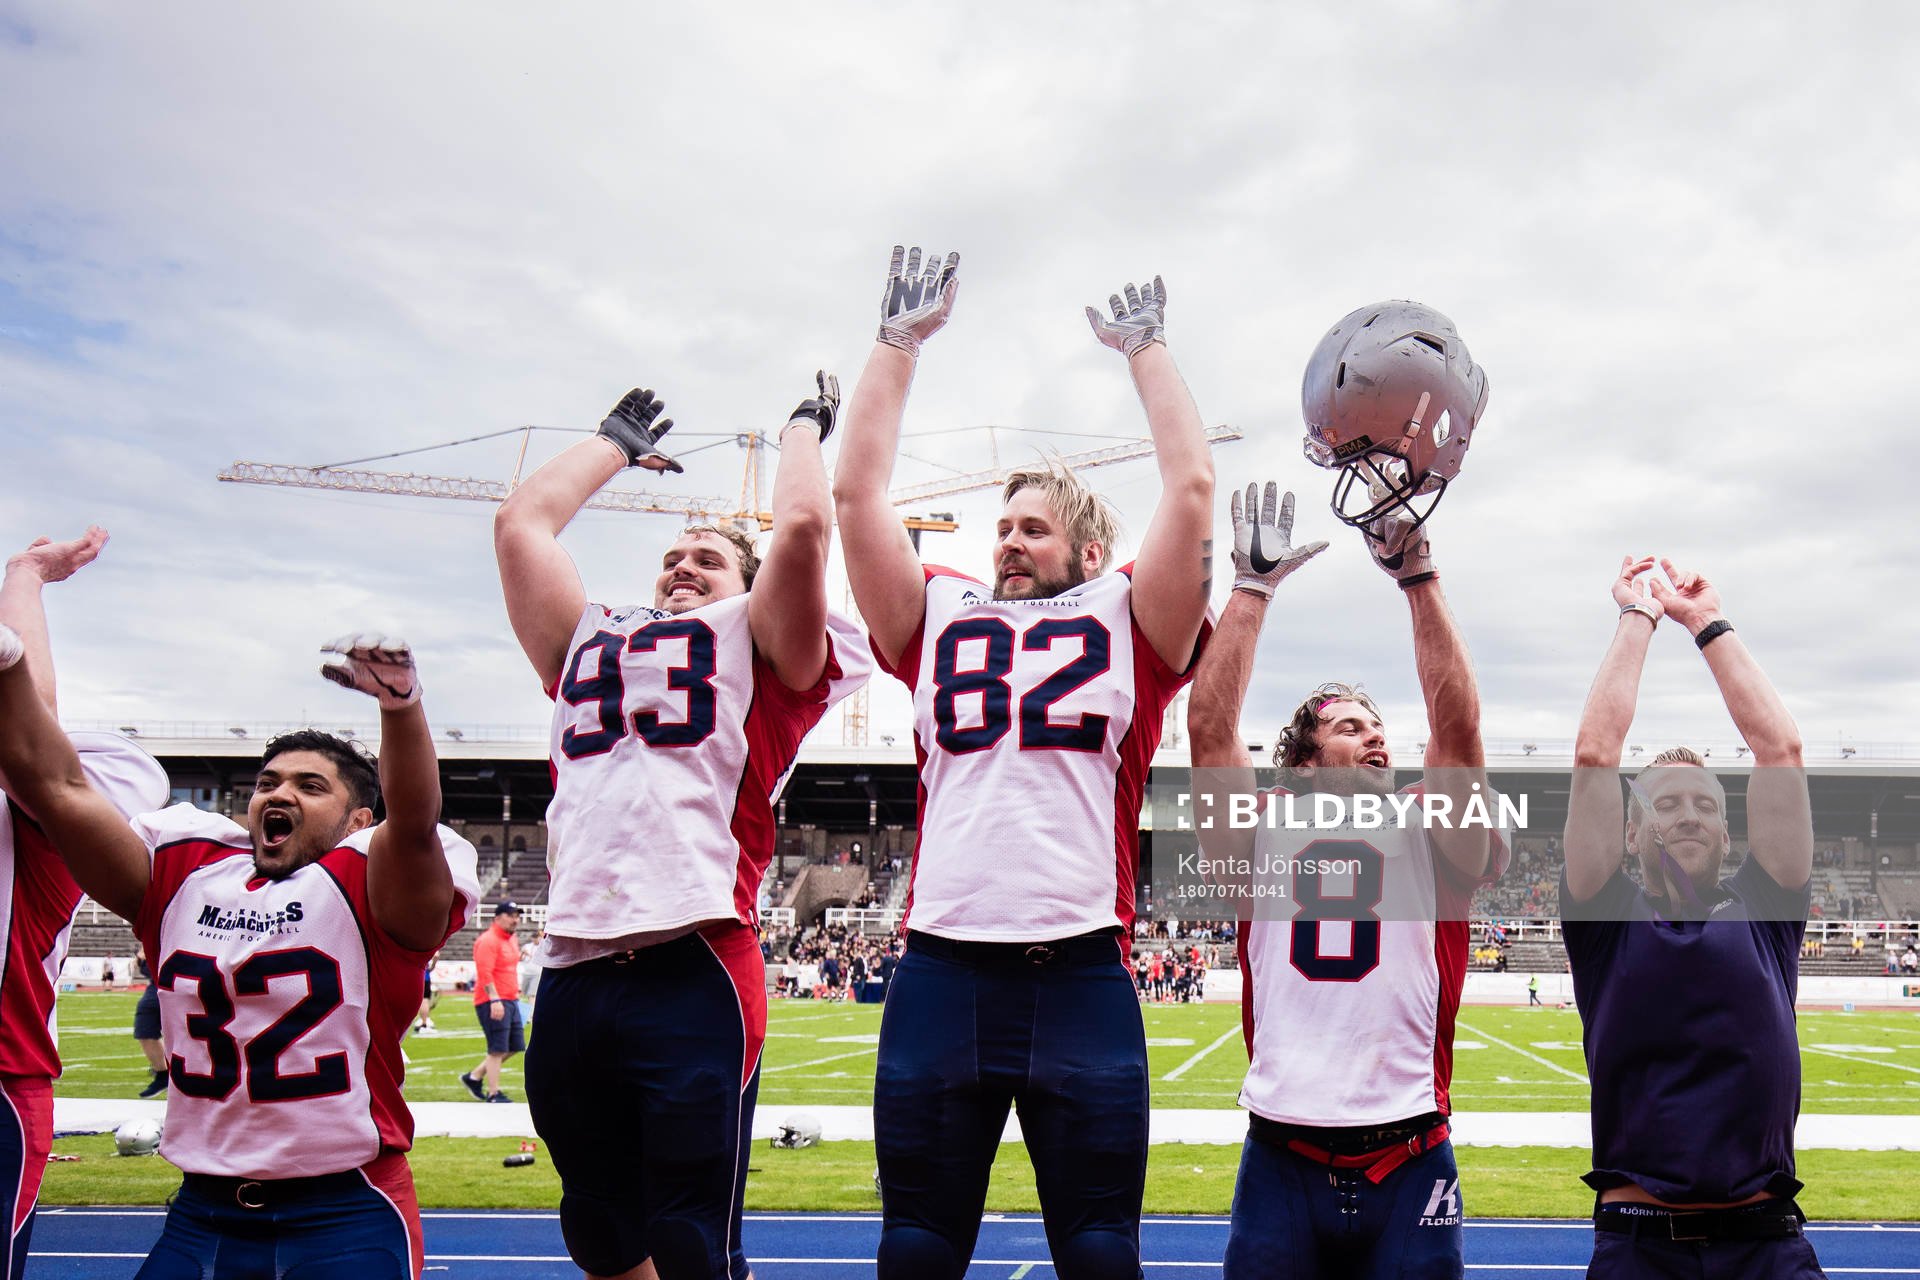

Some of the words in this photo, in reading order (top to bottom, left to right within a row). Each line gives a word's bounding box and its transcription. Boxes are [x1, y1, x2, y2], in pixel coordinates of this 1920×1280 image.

[1337, 440, 1366, 458] PMA
[561, 618, 717, 761] 93
[933, 615, 1111, 756] 82
[1289, 839, 1384, 982] 8
[158, 946, 351, 1103] 32
[1620, 1206, 1654, 1216] BJÖRN
